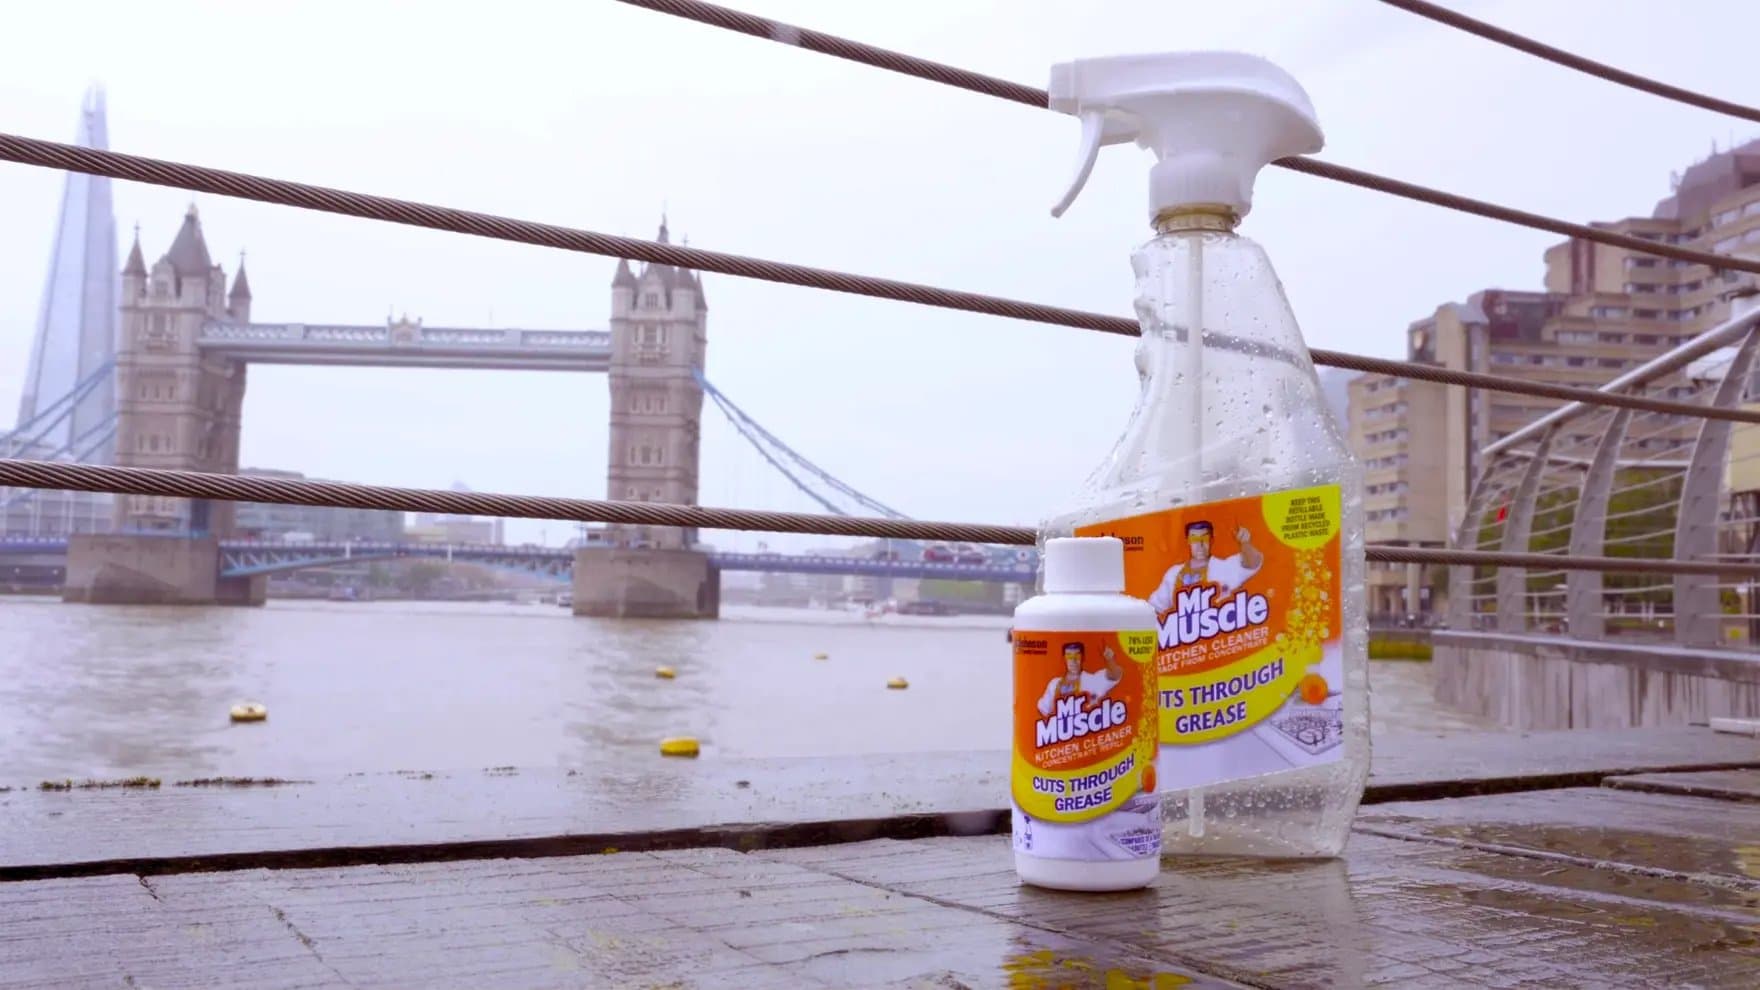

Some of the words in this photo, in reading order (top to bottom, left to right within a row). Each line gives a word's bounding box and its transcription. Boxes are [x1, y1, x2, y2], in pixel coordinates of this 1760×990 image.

[1178, 587, 1216, 614] Mr
[1208, 638, 1268, 661] CONCENTRATE
[1211, 626, 1269, 650] CLEANER
[1190, 657, 1283, 702] THROUGH
[1057, 695, 1086, 718] Mr
[1175, 701, 1246, 734] GREASE
[1036, 699, 1127, 748] Muscle
[1035, 744, 1079, 764] KITCHEN
[1083, 725, 1132, 750] CLEANER
[1042, 748, 1097, 769] CONCENTRATE
[1033, 776, 1065, 793] CUTS
[1069, 754, 1135, 792] THROUGH
[1055, 787, 1113, 812] GREASE
